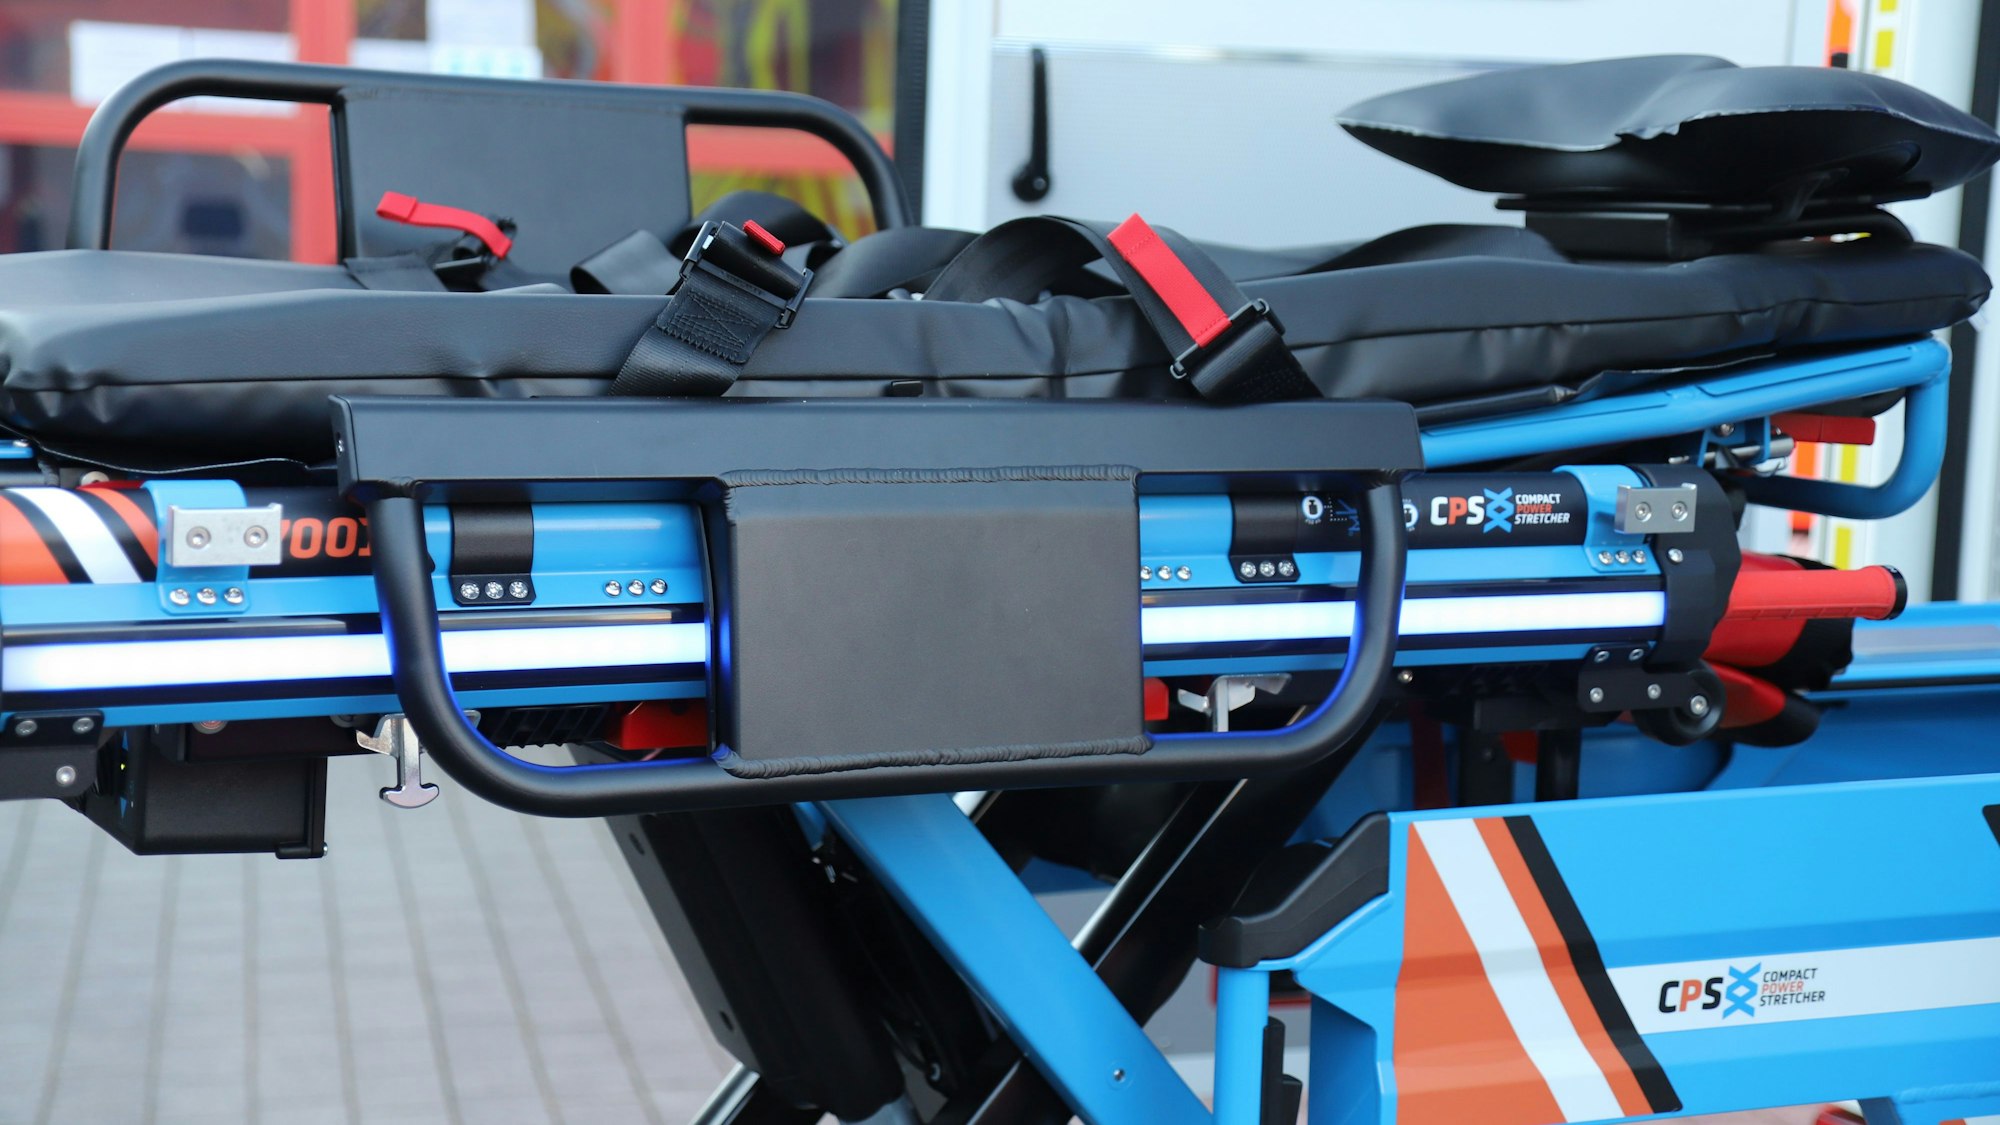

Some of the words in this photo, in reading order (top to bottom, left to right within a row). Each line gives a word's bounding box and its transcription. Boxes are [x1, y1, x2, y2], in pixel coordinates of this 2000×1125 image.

[1515, 493, 1561, 504] COMPACT
[1516, 503, 1552, 514] POWER
[1514, 513, 1570, 525] STRETCHER
[1763, 968, 1818, 983] COMPACT
[1761, 981, 1804, 995] POWER
[1759, 991, 1826, 1007] STRETCHER
